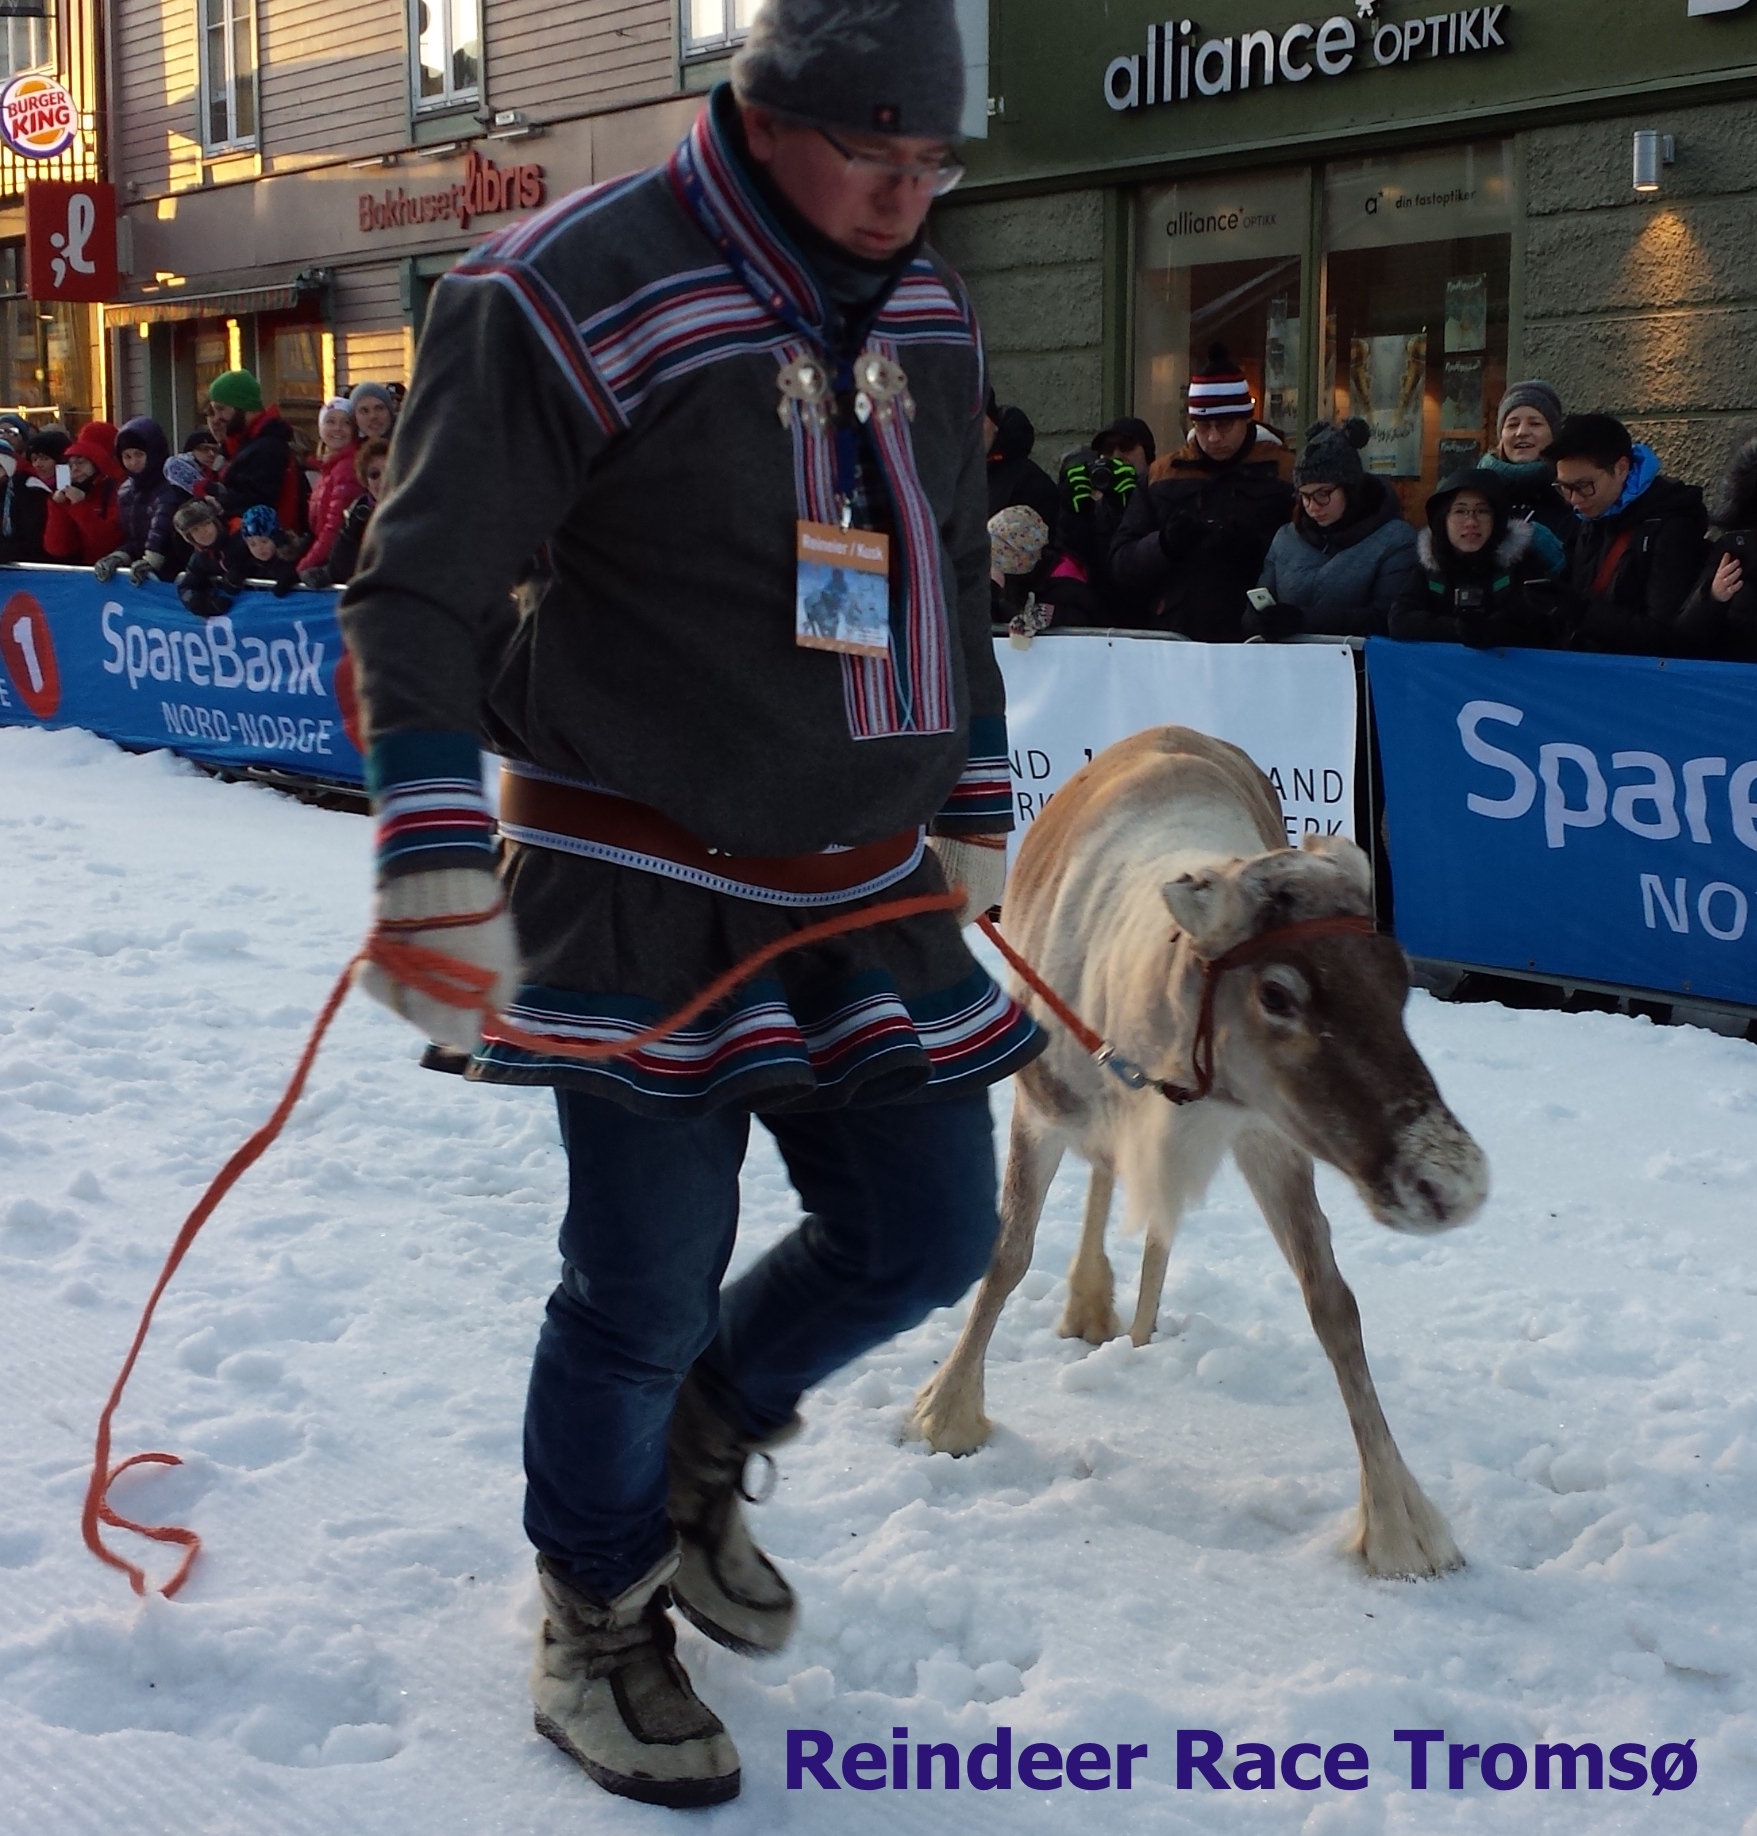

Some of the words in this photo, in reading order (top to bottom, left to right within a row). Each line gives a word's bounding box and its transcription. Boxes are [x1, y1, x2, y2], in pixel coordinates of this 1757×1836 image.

[1104, 15, 1356, 111] alliance
[1373, 4, 1505, 66] OPTIKK
[8, 91, 67, 119] BURGER
[12, 106, 71, 141] KING
[1396, 195, 1413, 209] din
[1415, 188, 1477, 207] fastoptiker
[1243, 214, 1277, 229] OPTIKK
[12, 616, 45, 694] 1
[102, 601, 327, 697] SpareBank
[161, 702, 334, 756] NORD-NORGE
